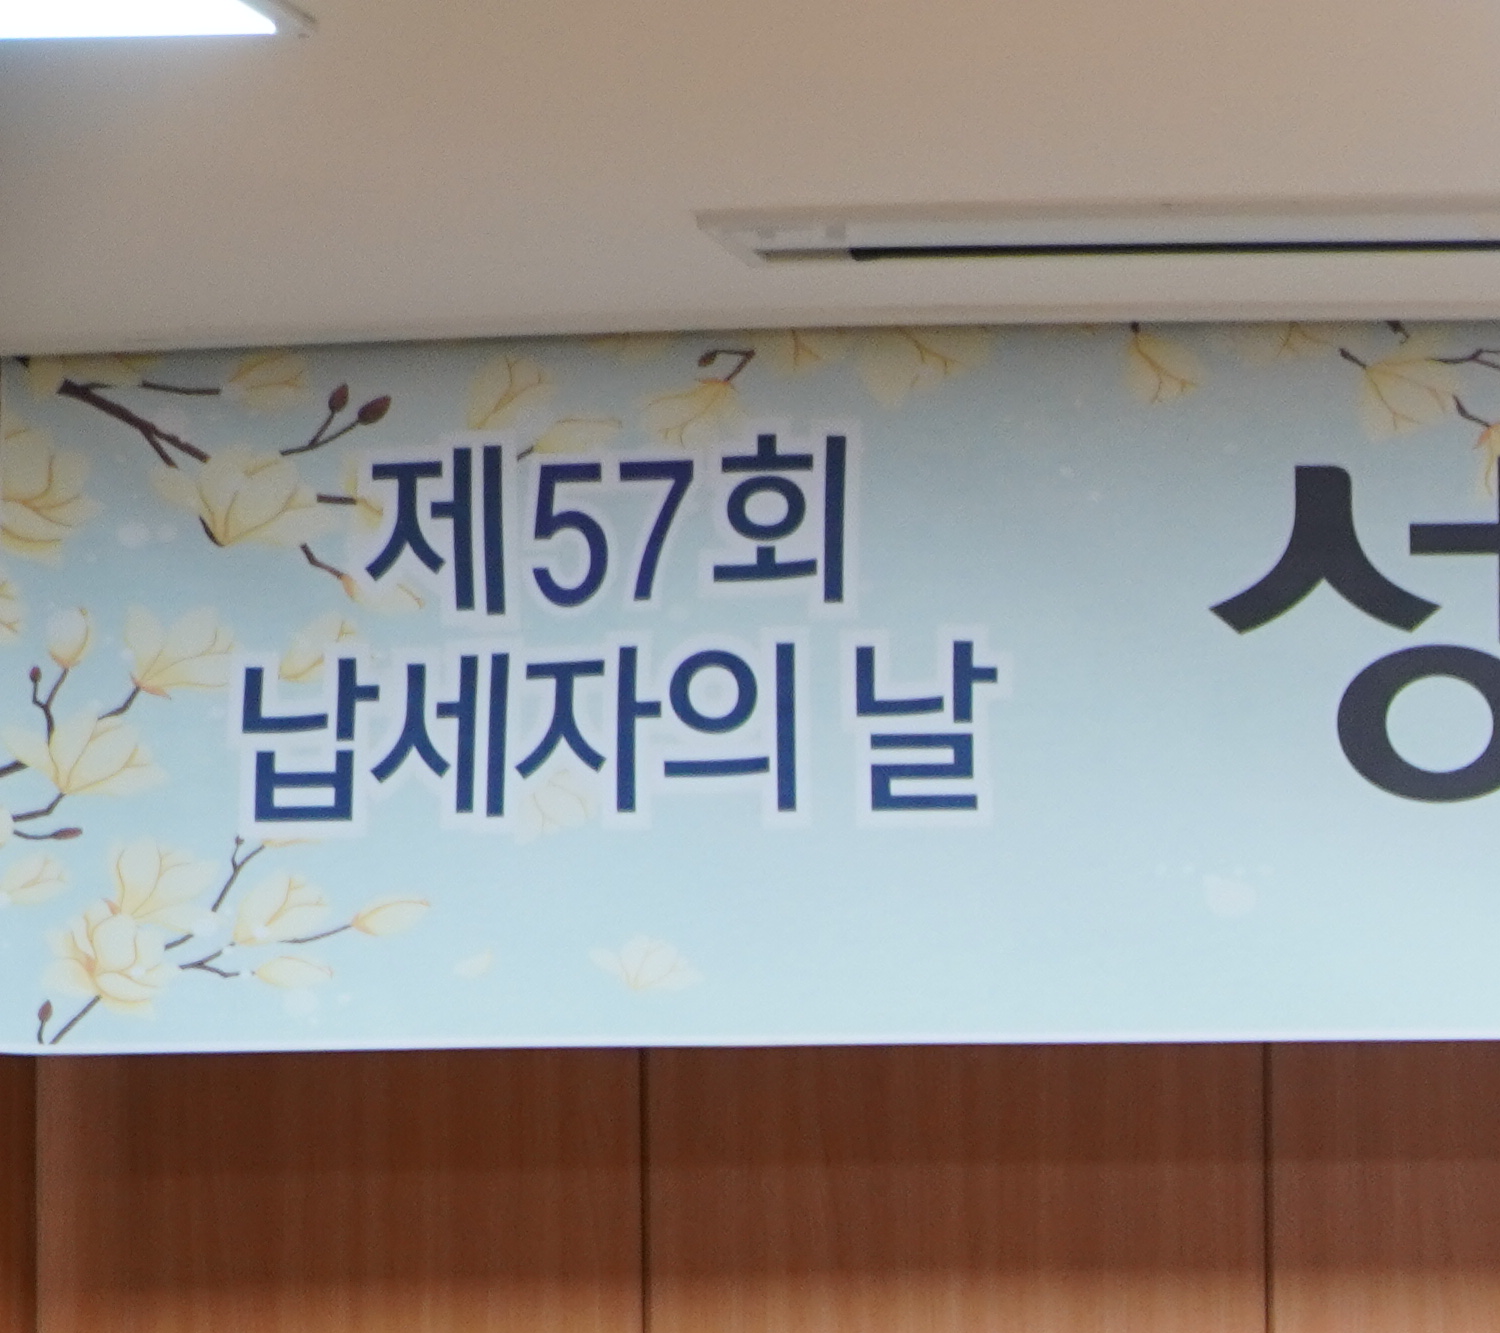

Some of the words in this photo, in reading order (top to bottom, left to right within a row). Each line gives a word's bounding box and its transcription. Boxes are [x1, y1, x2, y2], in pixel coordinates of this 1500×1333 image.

[365, 433, 848, 616] 제57회
[240, 641, 798, 822] 납세자의
[855, 640, 998, 811] 날
